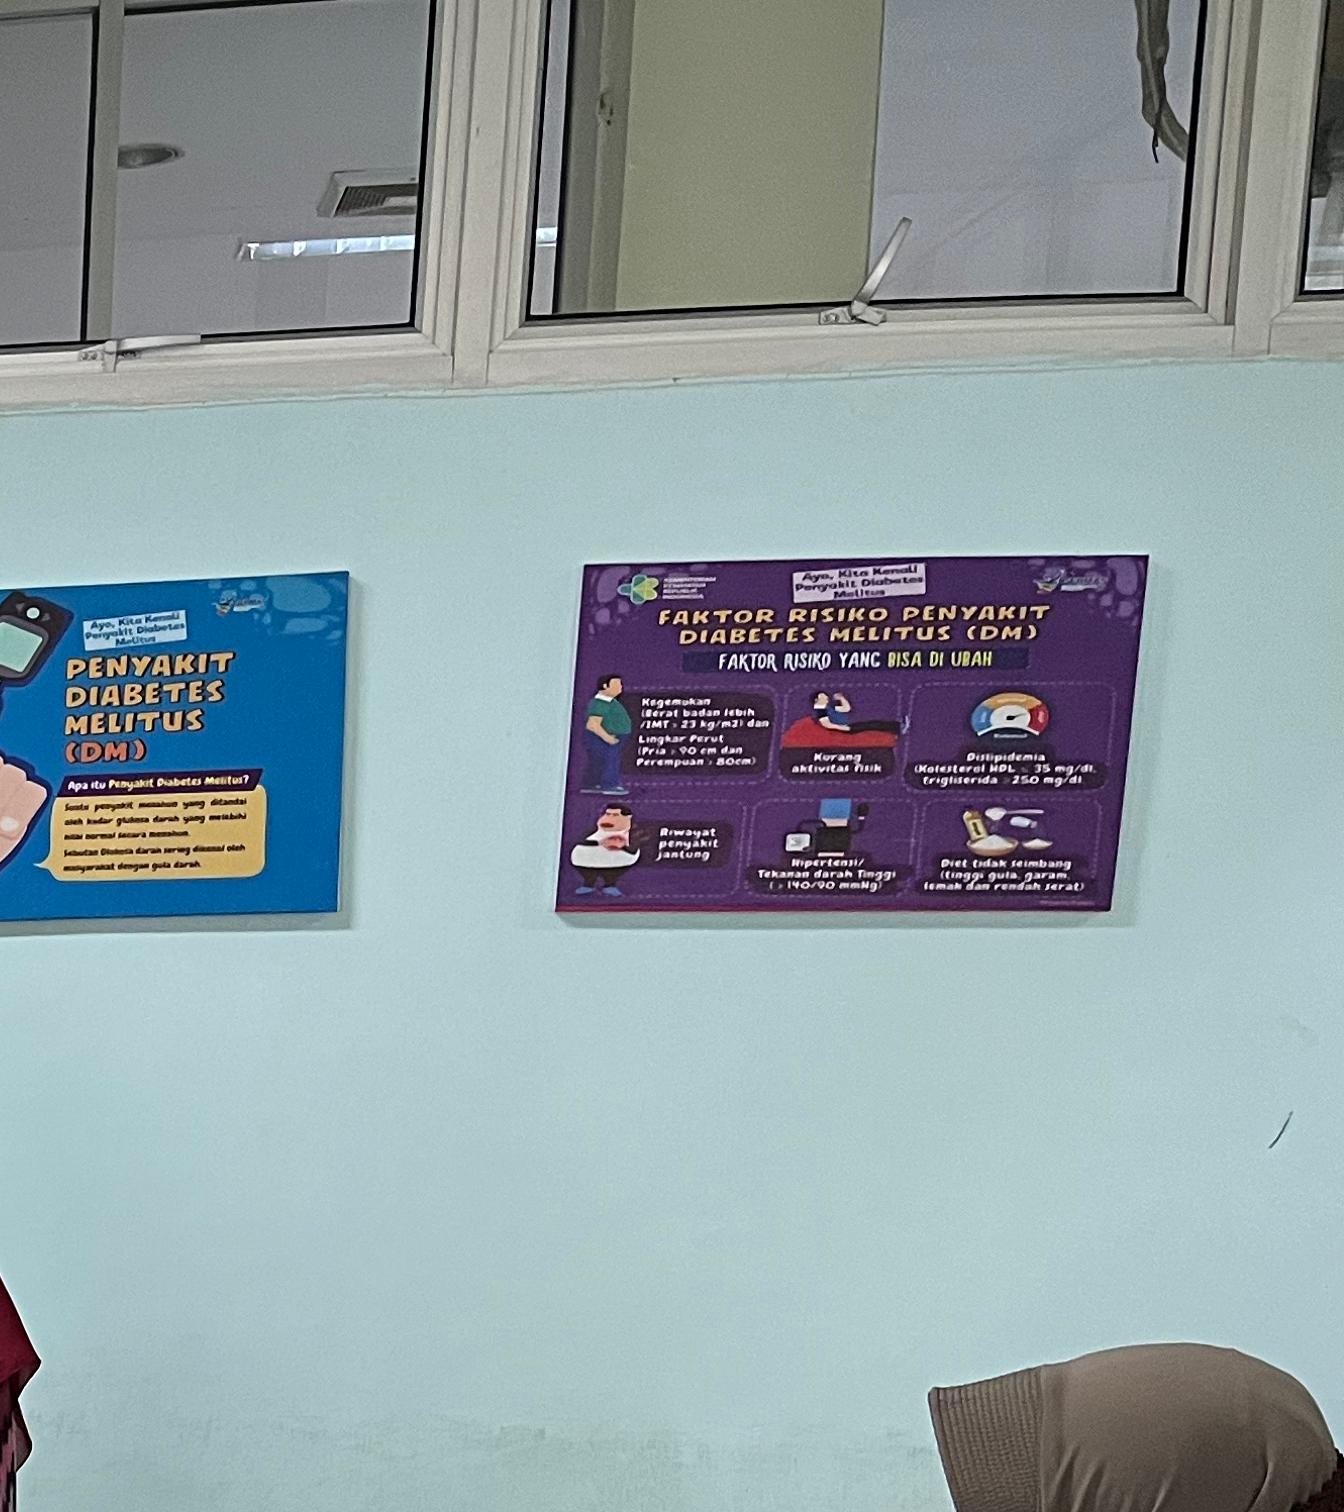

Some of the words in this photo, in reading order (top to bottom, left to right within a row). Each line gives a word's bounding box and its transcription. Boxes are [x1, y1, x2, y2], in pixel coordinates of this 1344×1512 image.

[838, 568, 869, 578] Kita
[873, 565, 918, 575] Kenali
[862, 576, 923, 586] Diabetes
[118, 617, 142, 625] Kita
[145, 613, 180, 623] Kenali
[659, 609, 775, 625] FAKTOR
[789, 607, 888, 623] RISIKO
[903, 605, 1050, 621] PENYAKIT
[85, 628, 133, 640] Penyakit
[137, 622, 185, 634] Diabetes
[679, 628, 815, 645] DIABETES
[830, 625, 951, 643] MELITUS
[967, 624, 1037, 641] (DM)
[66, 652, 235, 680] PENYAKIT
[719, 653, 778, 672] FAKTOR
[784, 652, 831, 672] RISIKO
[839, 652, 880, 668] YANG
[888, 652, 921, 668] BISA
[929, 652, 943, 667] DI
[951, 651, 992, 667] UBAH
[65, 679, 224, 708] DIABETES
[65, 709, 204, 735] MELITUS
[65, 739, 146, 763] (DM)
[67, 781, 88, 792] Apa
[108, 779, 154, 791] Penyakit
[157, 778, 201, 788] Diabetes
